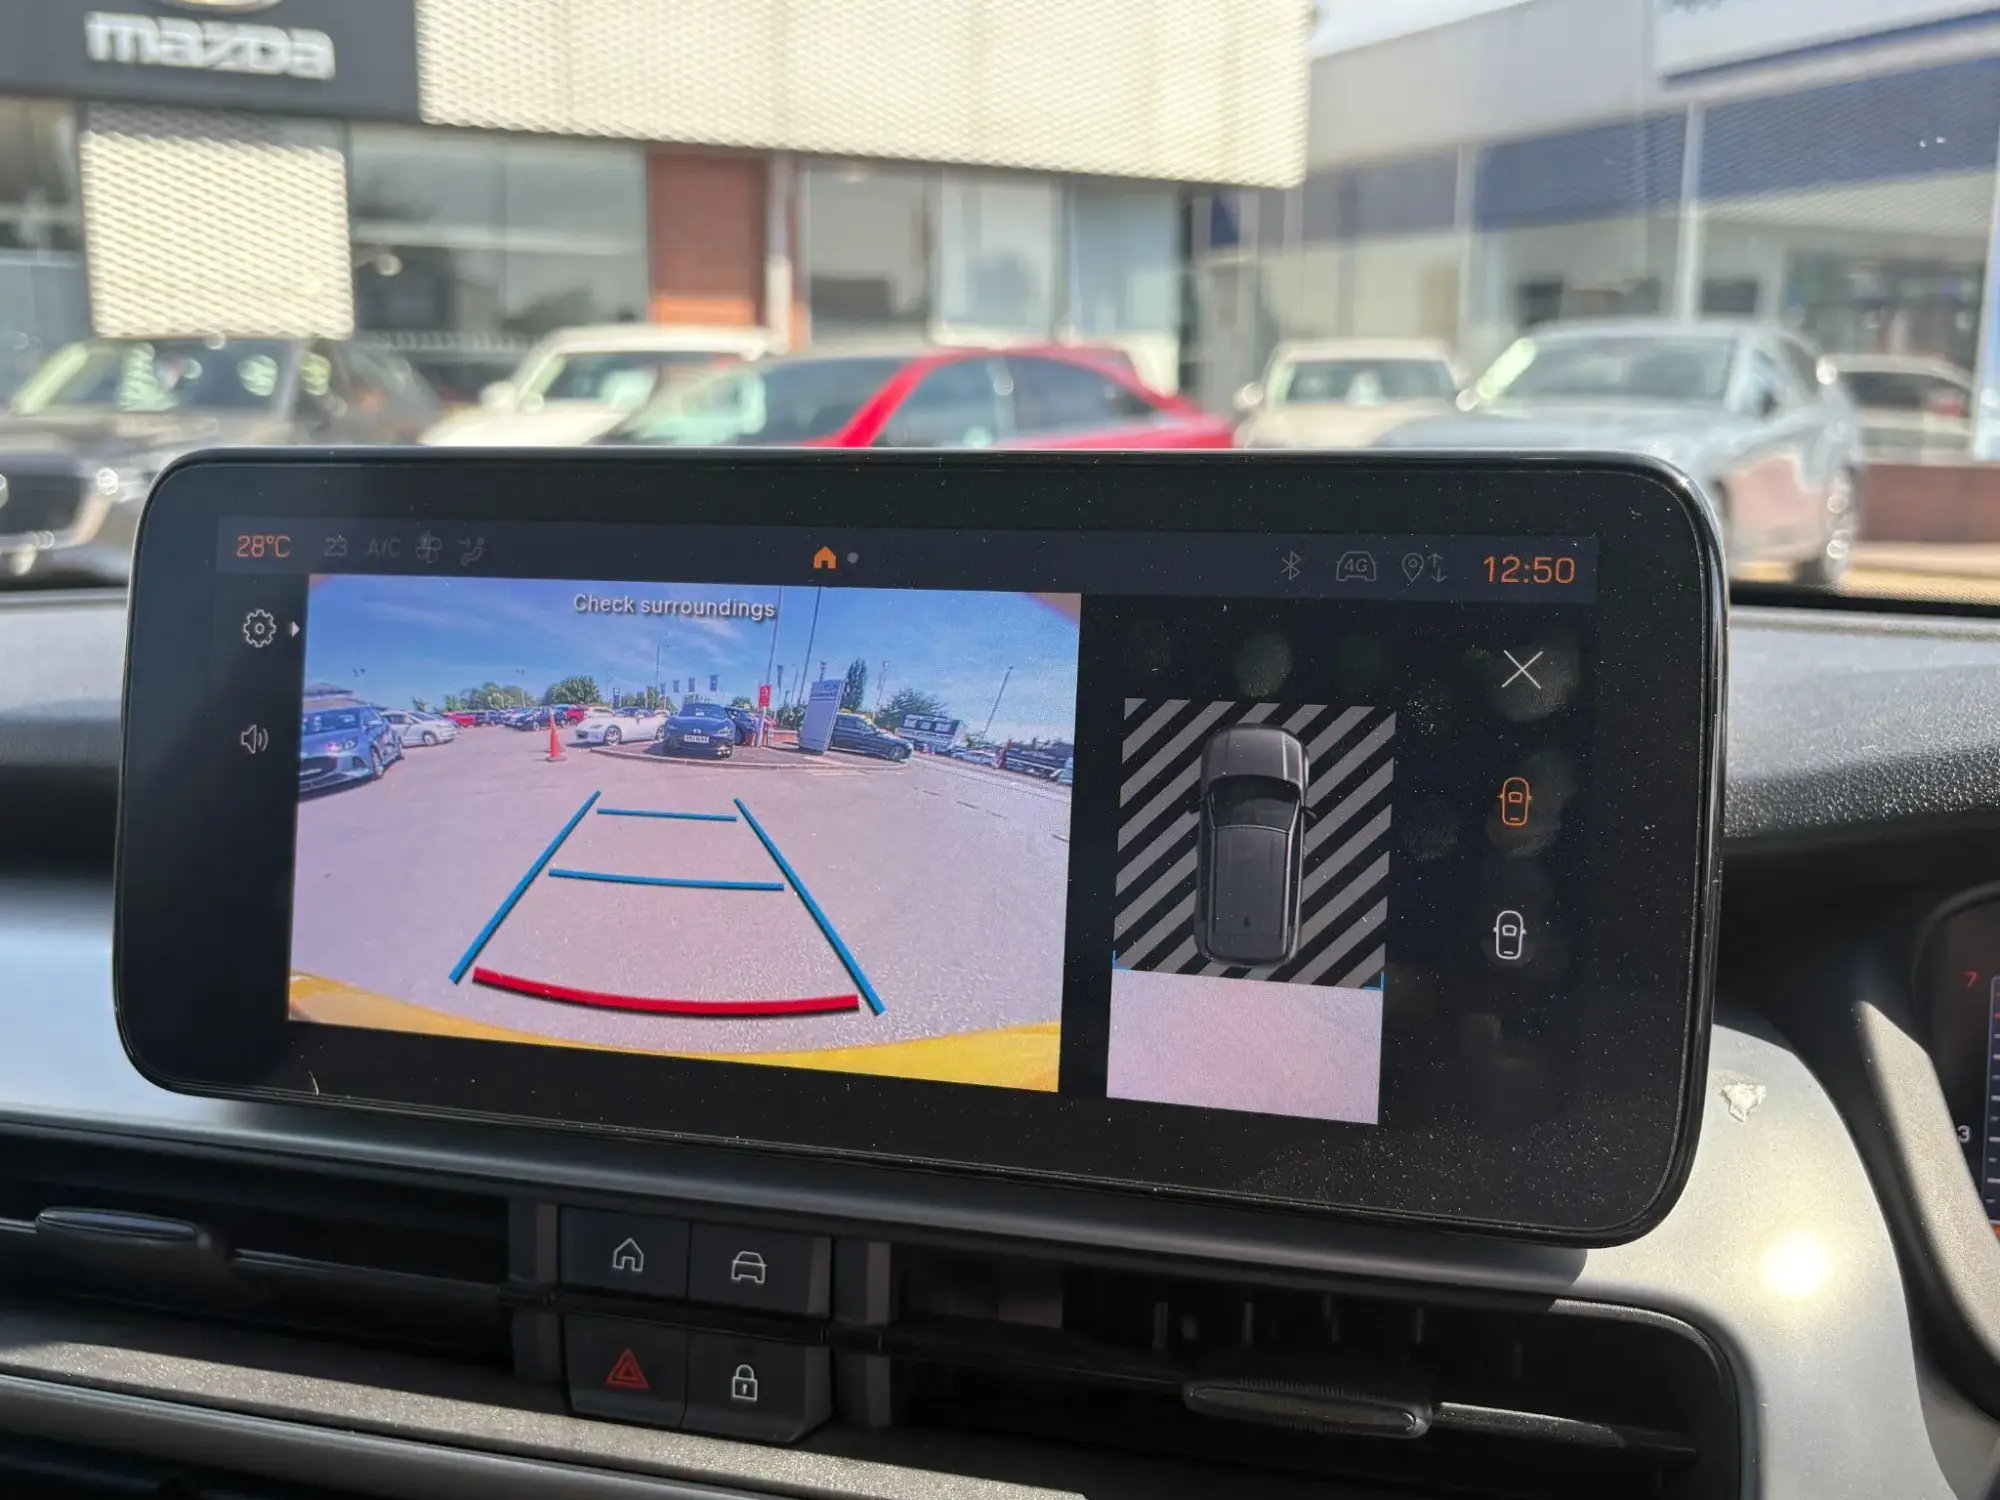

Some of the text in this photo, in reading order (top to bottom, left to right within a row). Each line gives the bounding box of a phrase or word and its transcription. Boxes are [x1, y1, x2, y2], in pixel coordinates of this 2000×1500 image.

[236, 534, 292, 558] 28°C
[324, 536, 348, 558] 23
[365, 538, 400, 558] A/C
[1344, 558, 1368, 573] 4G
[1483, 556, 1576, 584] 12:50
[573, 593, 776, 621] Check surroundings
[1964, 970, 1979, 988] 7
[1957, 1125, 1971, 1143] 3
